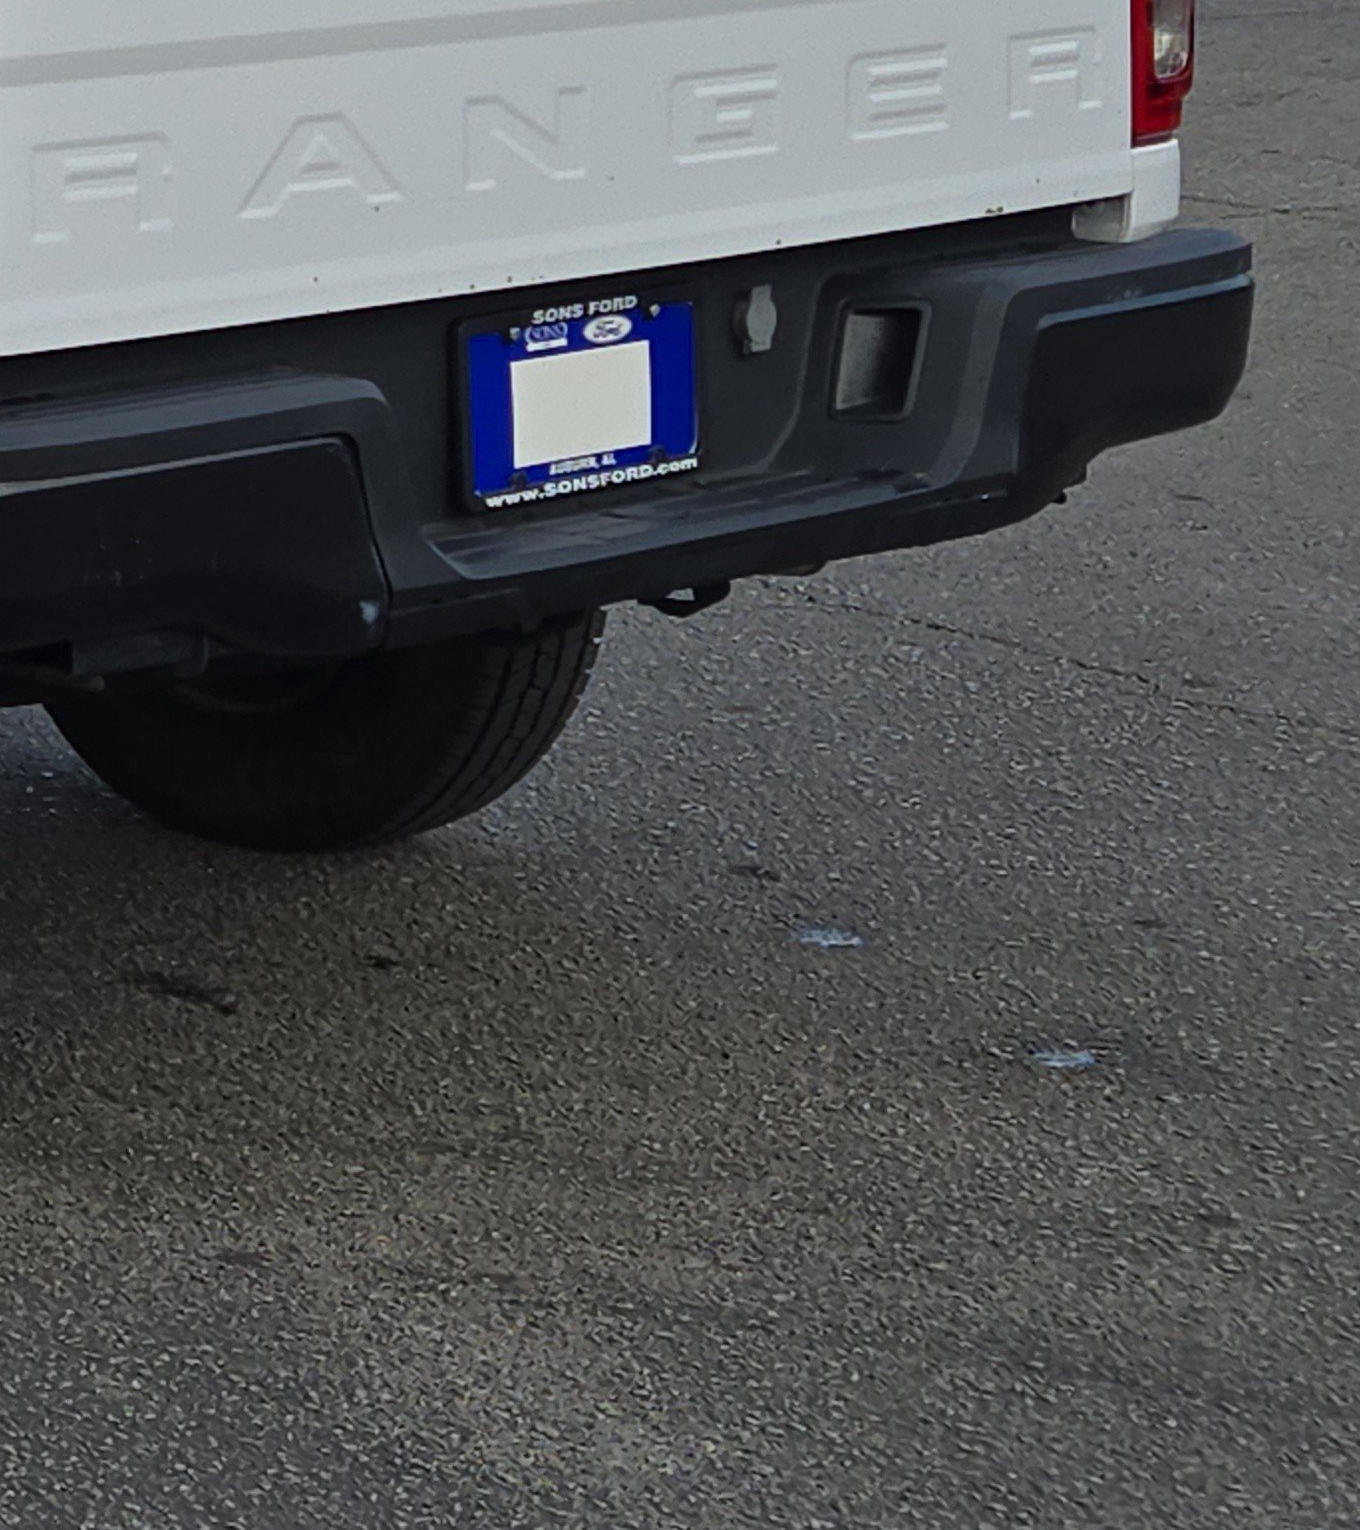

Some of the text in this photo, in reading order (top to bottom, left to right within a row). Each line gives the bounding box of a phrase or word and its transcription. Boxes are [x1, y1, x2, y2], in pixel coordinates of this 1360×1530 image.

[31, 25, 1104, 244] RANGER
[531, 295, 638, 325] SONS FORD
[485, 457, 698, 508] www.SONSFORD.com
